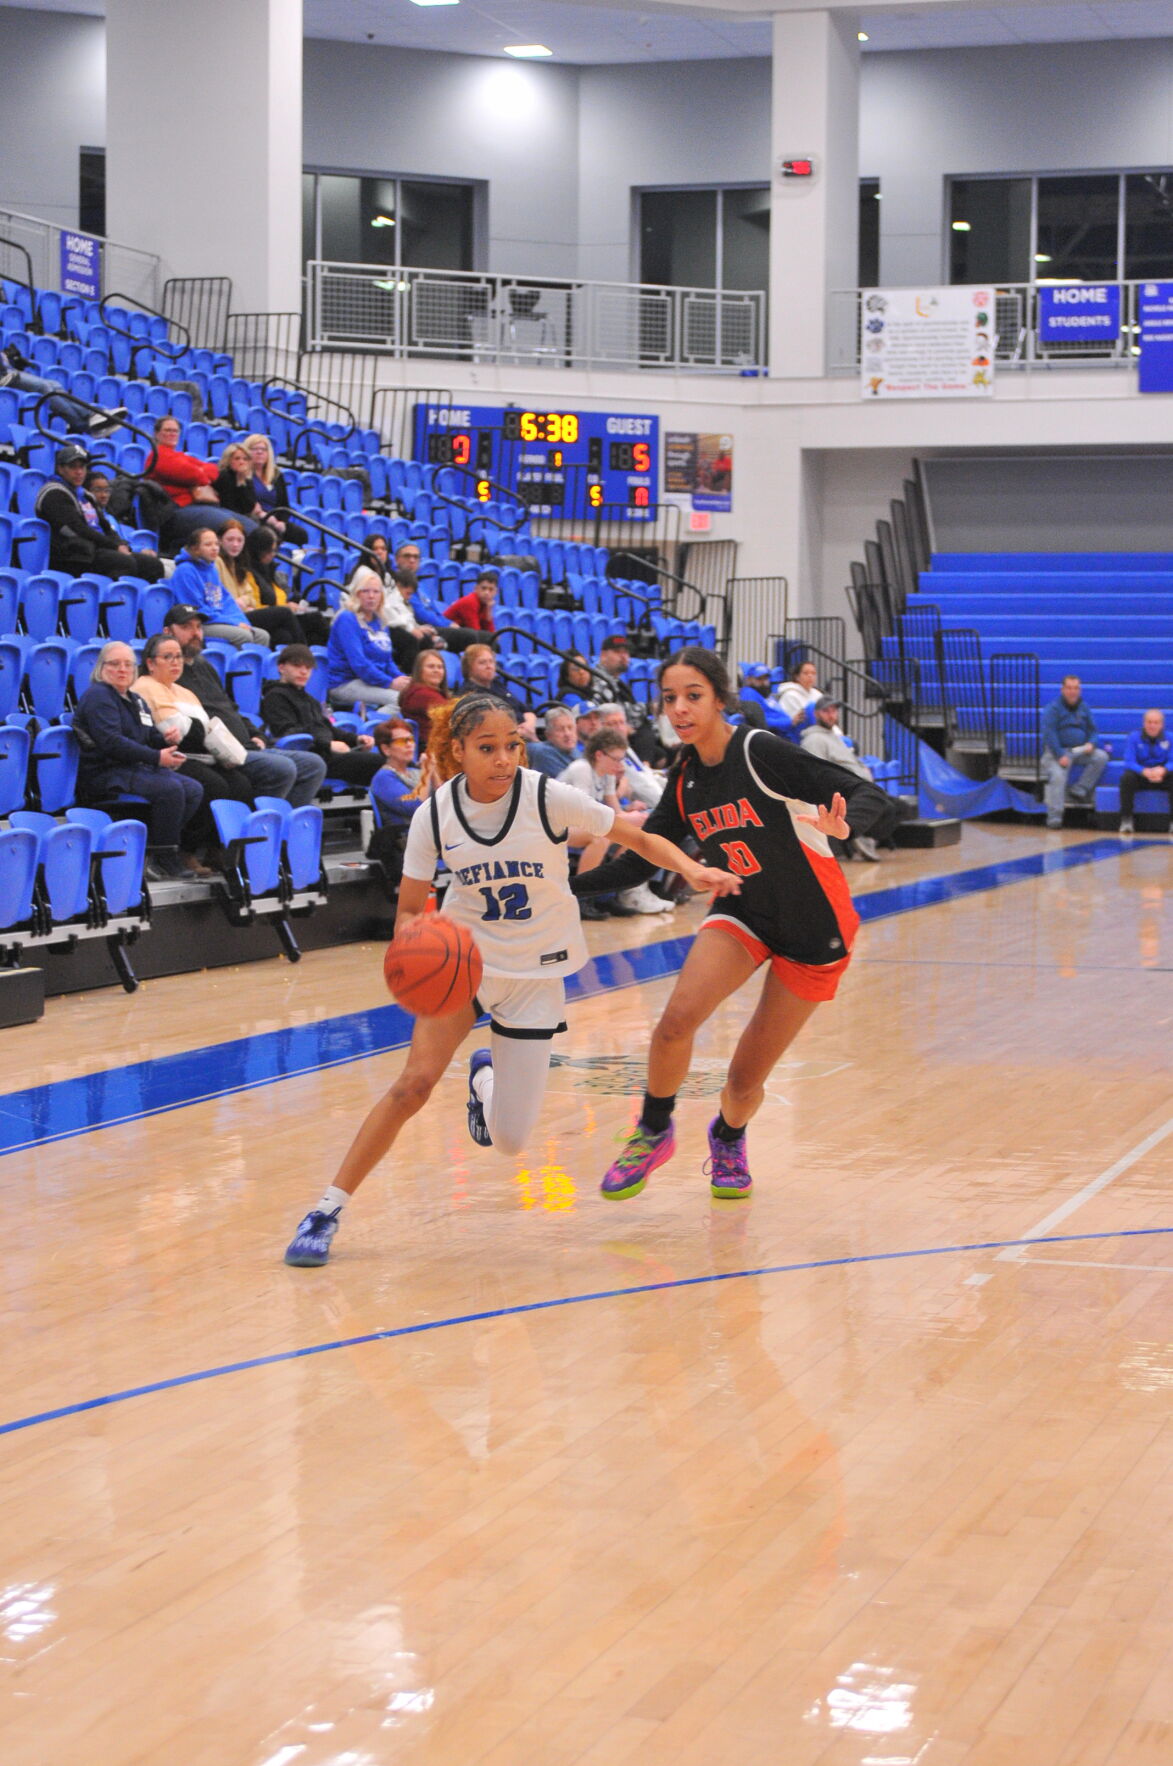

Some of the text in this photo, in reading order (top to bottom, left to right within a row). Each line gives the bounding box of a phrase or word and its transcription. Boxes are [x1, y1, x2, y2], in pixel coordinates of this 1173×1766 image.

[66, 235, 93, 256] HOME
[1053, 288, 1107, 304] HOME
[1048, 315, 1112, 328] STUDENTS
[428, 409, 470, 427] HOME
[606, 417, 652, 435] GUEST
[633, 443, 651, 472] 5
[688, 797, 764, 841] ELIDA
[479, 883, 532, 921] 12
